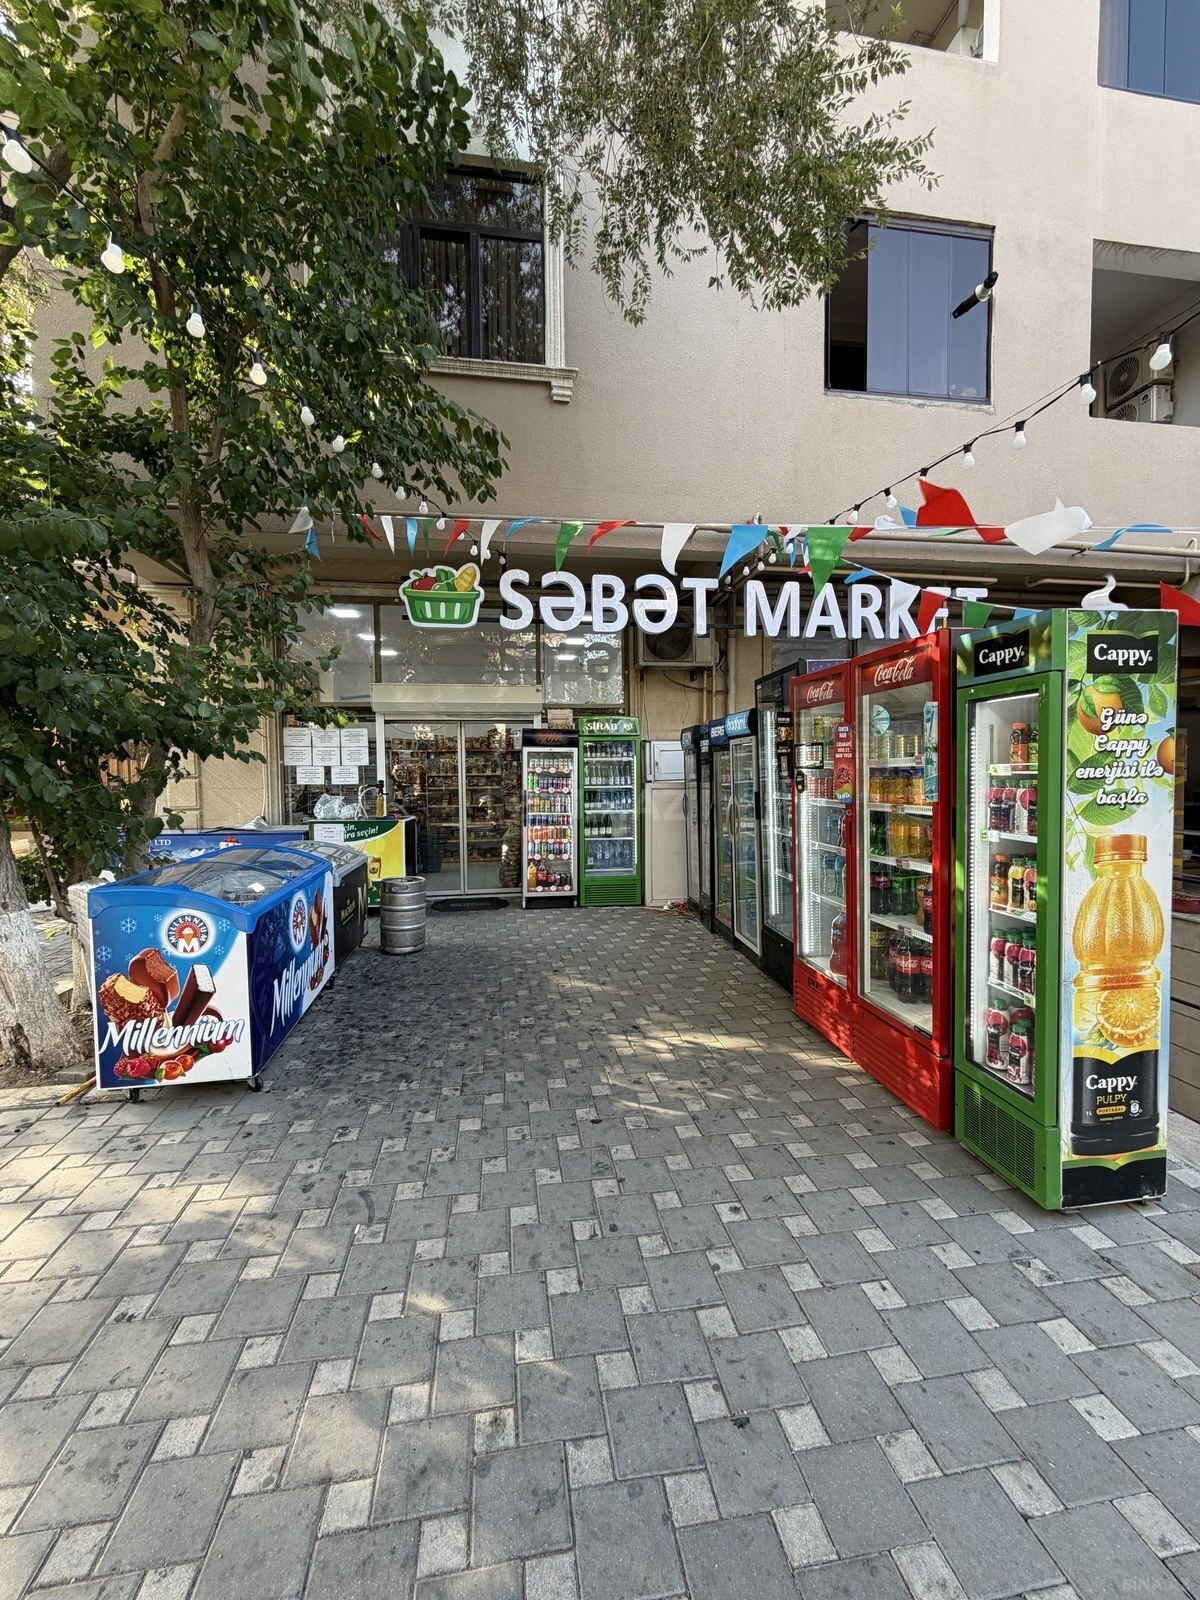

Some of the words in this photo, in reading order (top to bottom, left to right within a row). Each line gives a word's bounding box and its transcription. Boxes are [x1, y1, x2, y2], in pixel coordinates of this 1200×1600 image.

[498, 568, 719, 637] SƏBƏT
[979, 645, 1024, 666] Cappy
[1093, 643, 1151, 666] Cappy
[874, 655, 916, 687] Coca-Cola
[807, 680, 835, 703] Coca-Cola
[1099, 706, 1149, 730] Günə
[1093, 734, 1151, 758] Cappy
[1075, 761, 1139, 785] enerjisi
[1139, 760, 1164, 778] ilə
[1096, 787, 1148, 810] başla
[356, 825, 379, 838] seçin!
[169, 915, 208, 944] MILLENNIUM
[99, 1017, 245, 1057] Millennium
[1085, 1074, 1138, 1093] Cappy
[1096, 1093, 1127, 1105] PULPY
